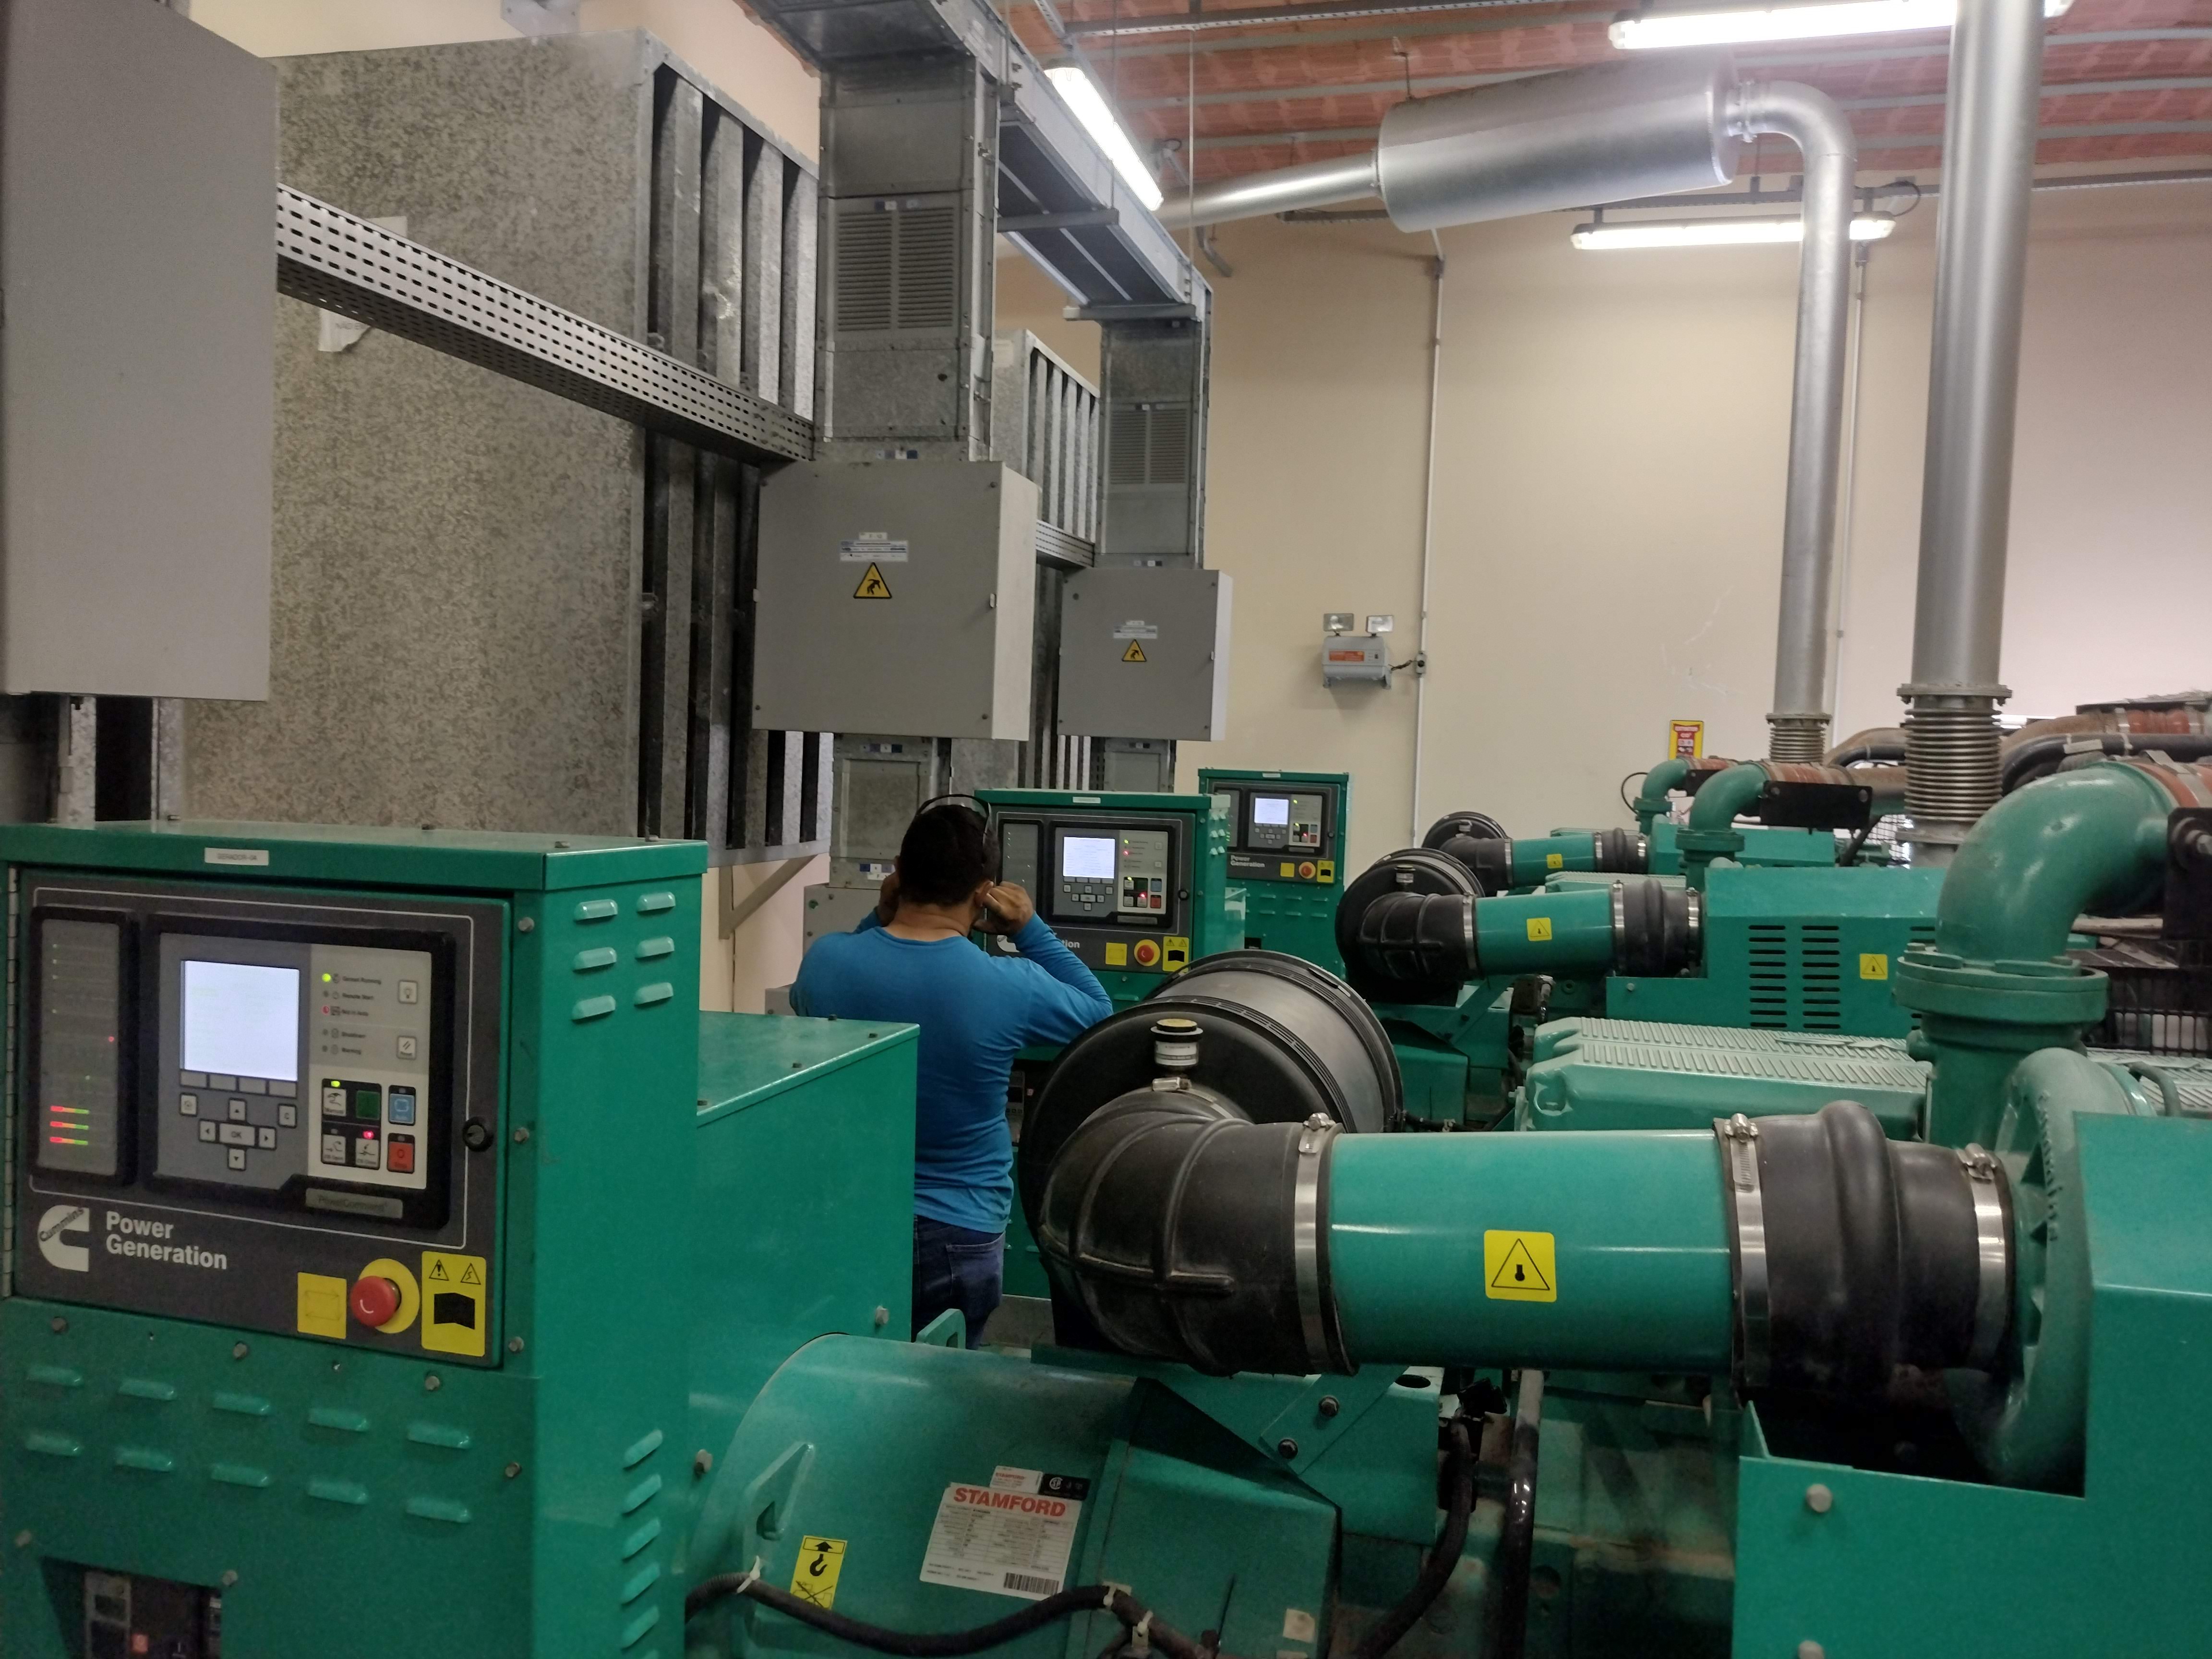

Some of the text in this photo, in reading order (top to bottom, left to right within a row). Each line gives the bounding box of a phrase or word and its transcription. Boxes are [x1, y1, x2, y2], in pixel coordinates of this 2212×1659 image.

[230, 1130, 242, 1139] OK
[39, 1207, 84, 1242] Cummins
[106, 1210, 175, 1239] Power
[106, 1233, 228, 1270] Generation
[953, 1487, 1066, 1517] STAMFORD
